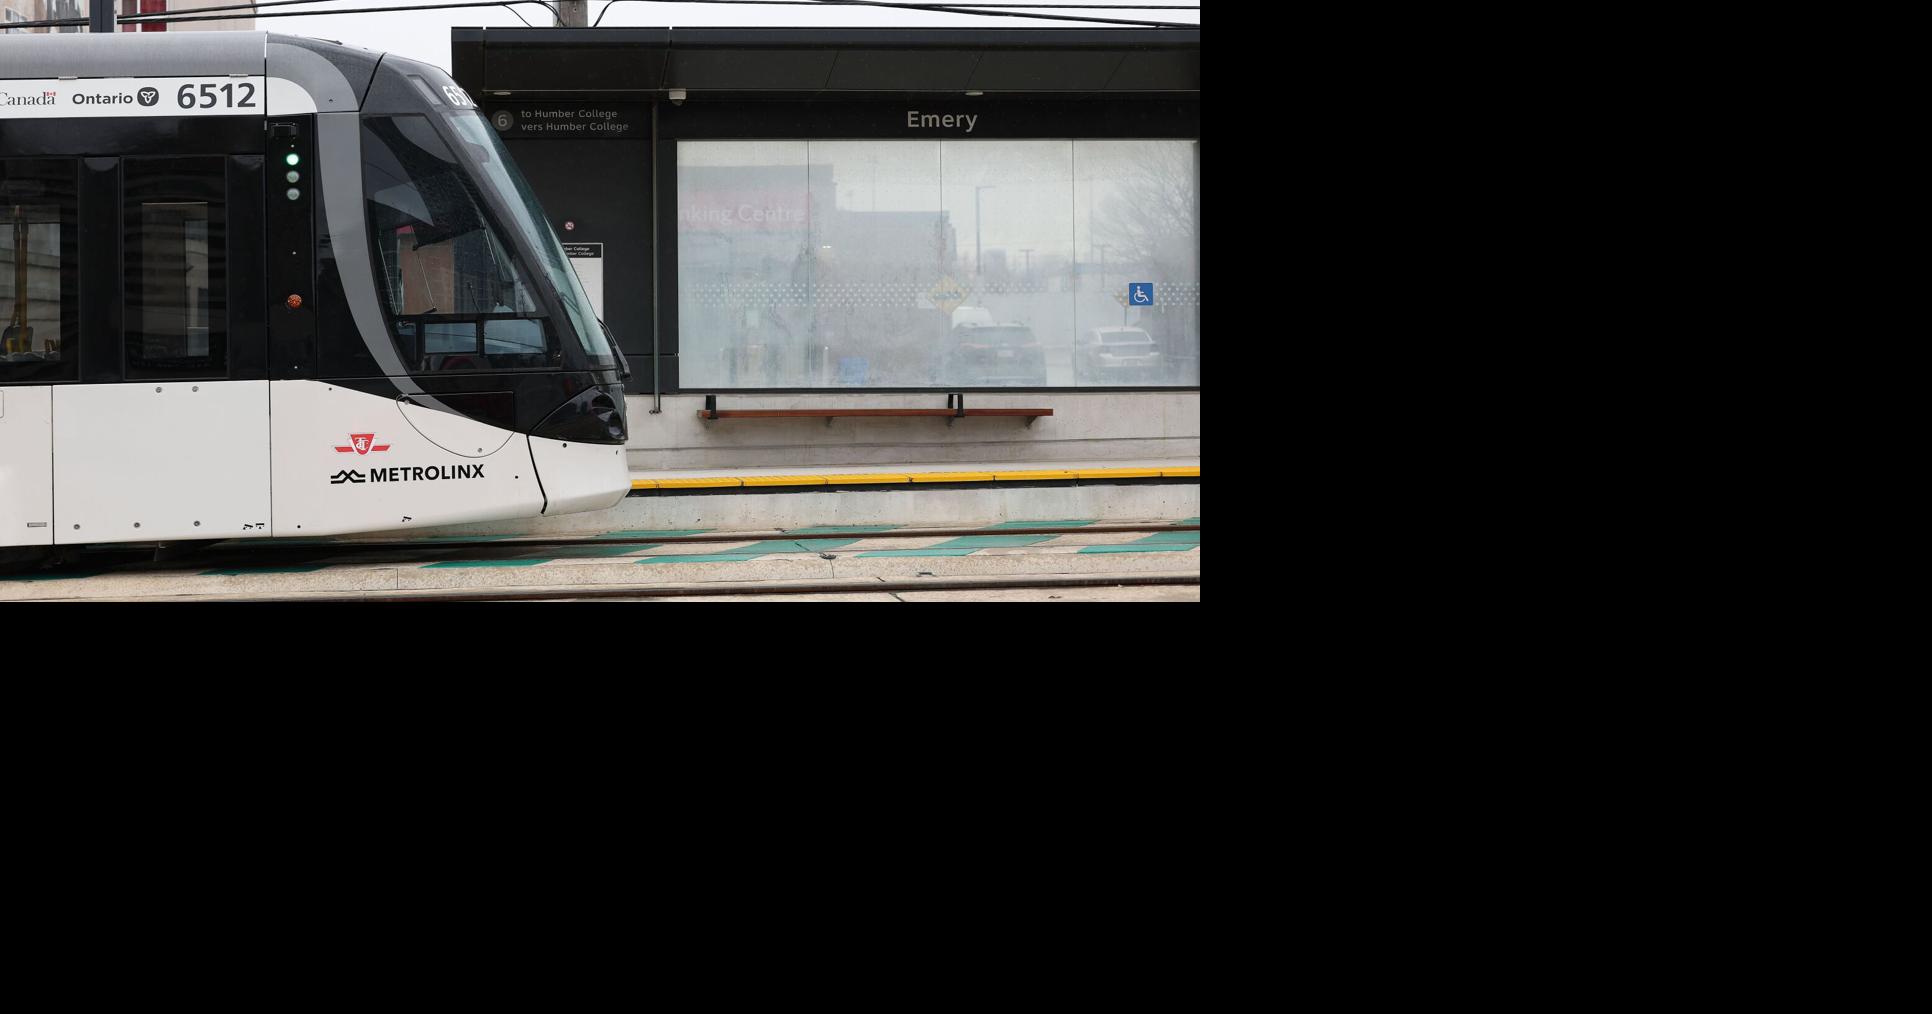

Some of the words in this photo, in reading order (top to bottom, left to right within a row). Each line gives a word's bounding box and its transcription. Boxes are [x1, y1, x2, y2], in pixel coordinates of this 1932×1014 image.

[72, 92, 133, 105] Ontario
[176, 82, 257, 109] 6512
[497, 114, 508, 127] 6
[521, 110, 532, 118] to
[535, 109, 574, 118] Humber
[578, 109, 618, 120] College
[907, 110, 978, 133] Emery
[521, 123, 543, 131] vers
[546, 122, 586, 131] Humber
[589, 122, 629, 133] College
[738, 204, 805, 222] Centre
[370, 464, 485, 482] METROLINX
